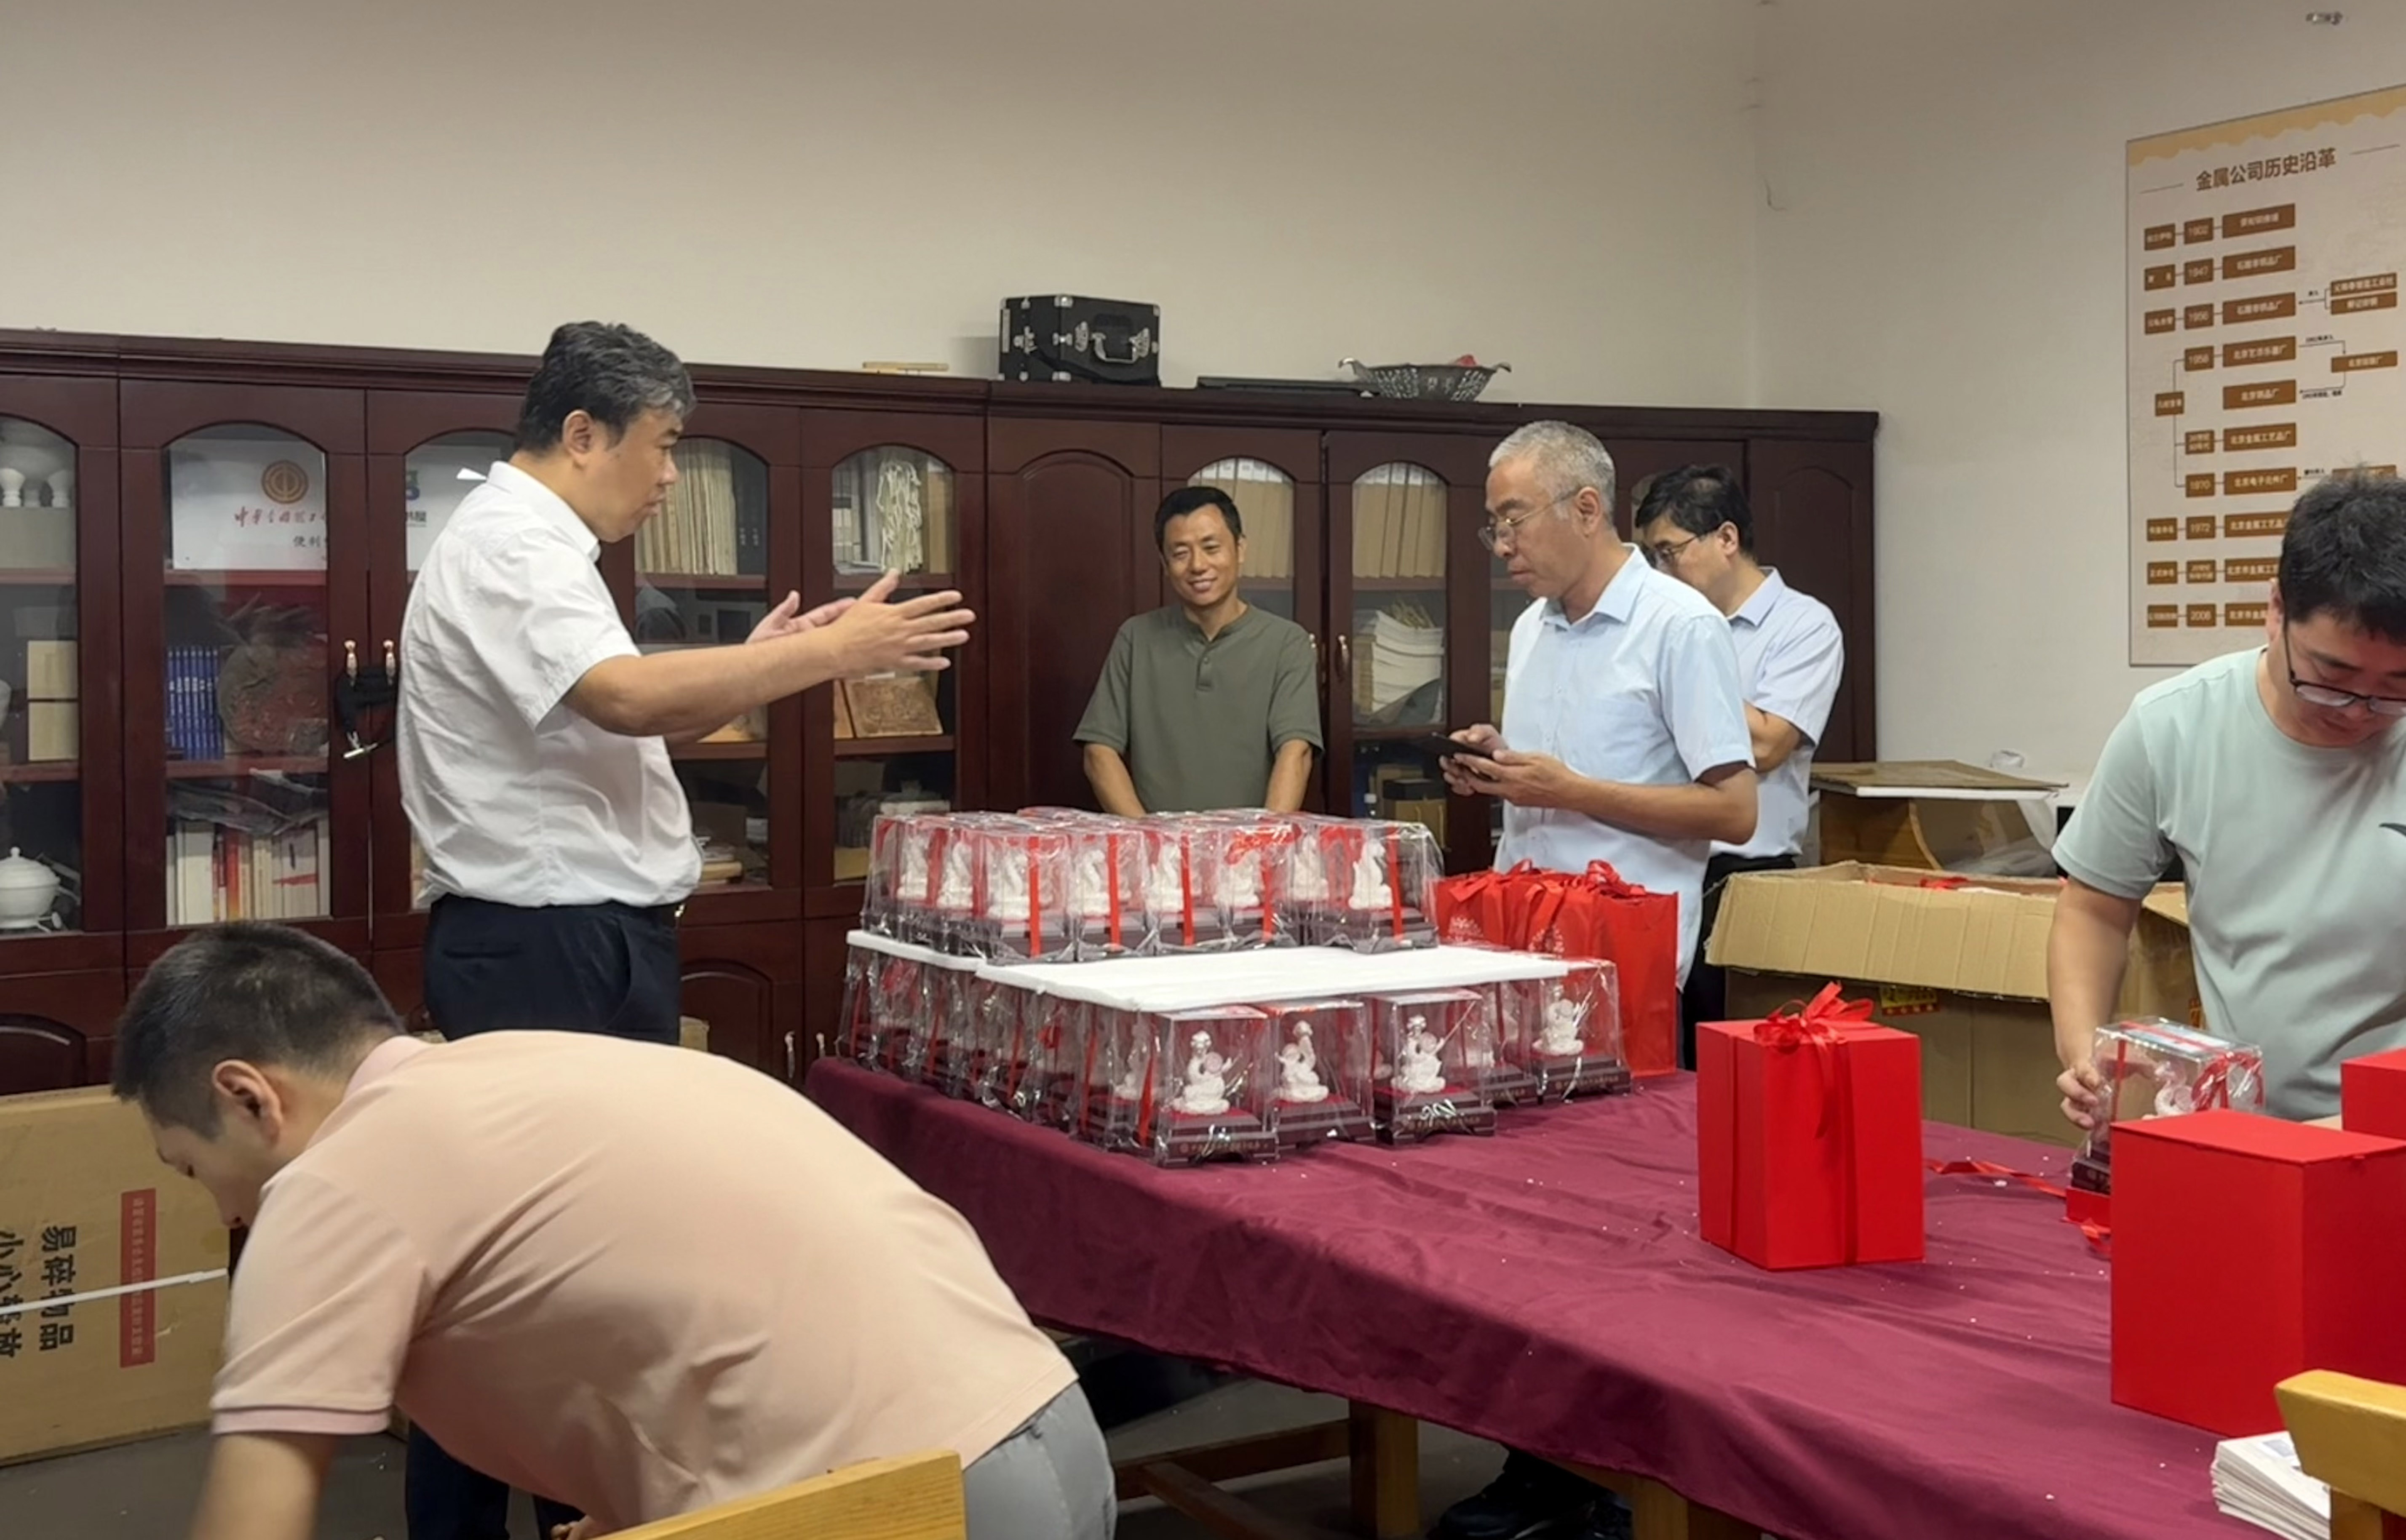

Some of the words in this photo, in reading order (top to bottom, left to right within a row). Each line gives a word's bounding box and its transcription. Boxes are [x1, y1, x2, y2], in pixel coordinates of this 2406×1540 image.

[2195, 147, 2336, 191] 金属公司历史沿革
[294, 534, 327, 548] 便利
[2189, 522, 2211, 533] 1972
[40, 1226, 76, 1351] 易碎物品
